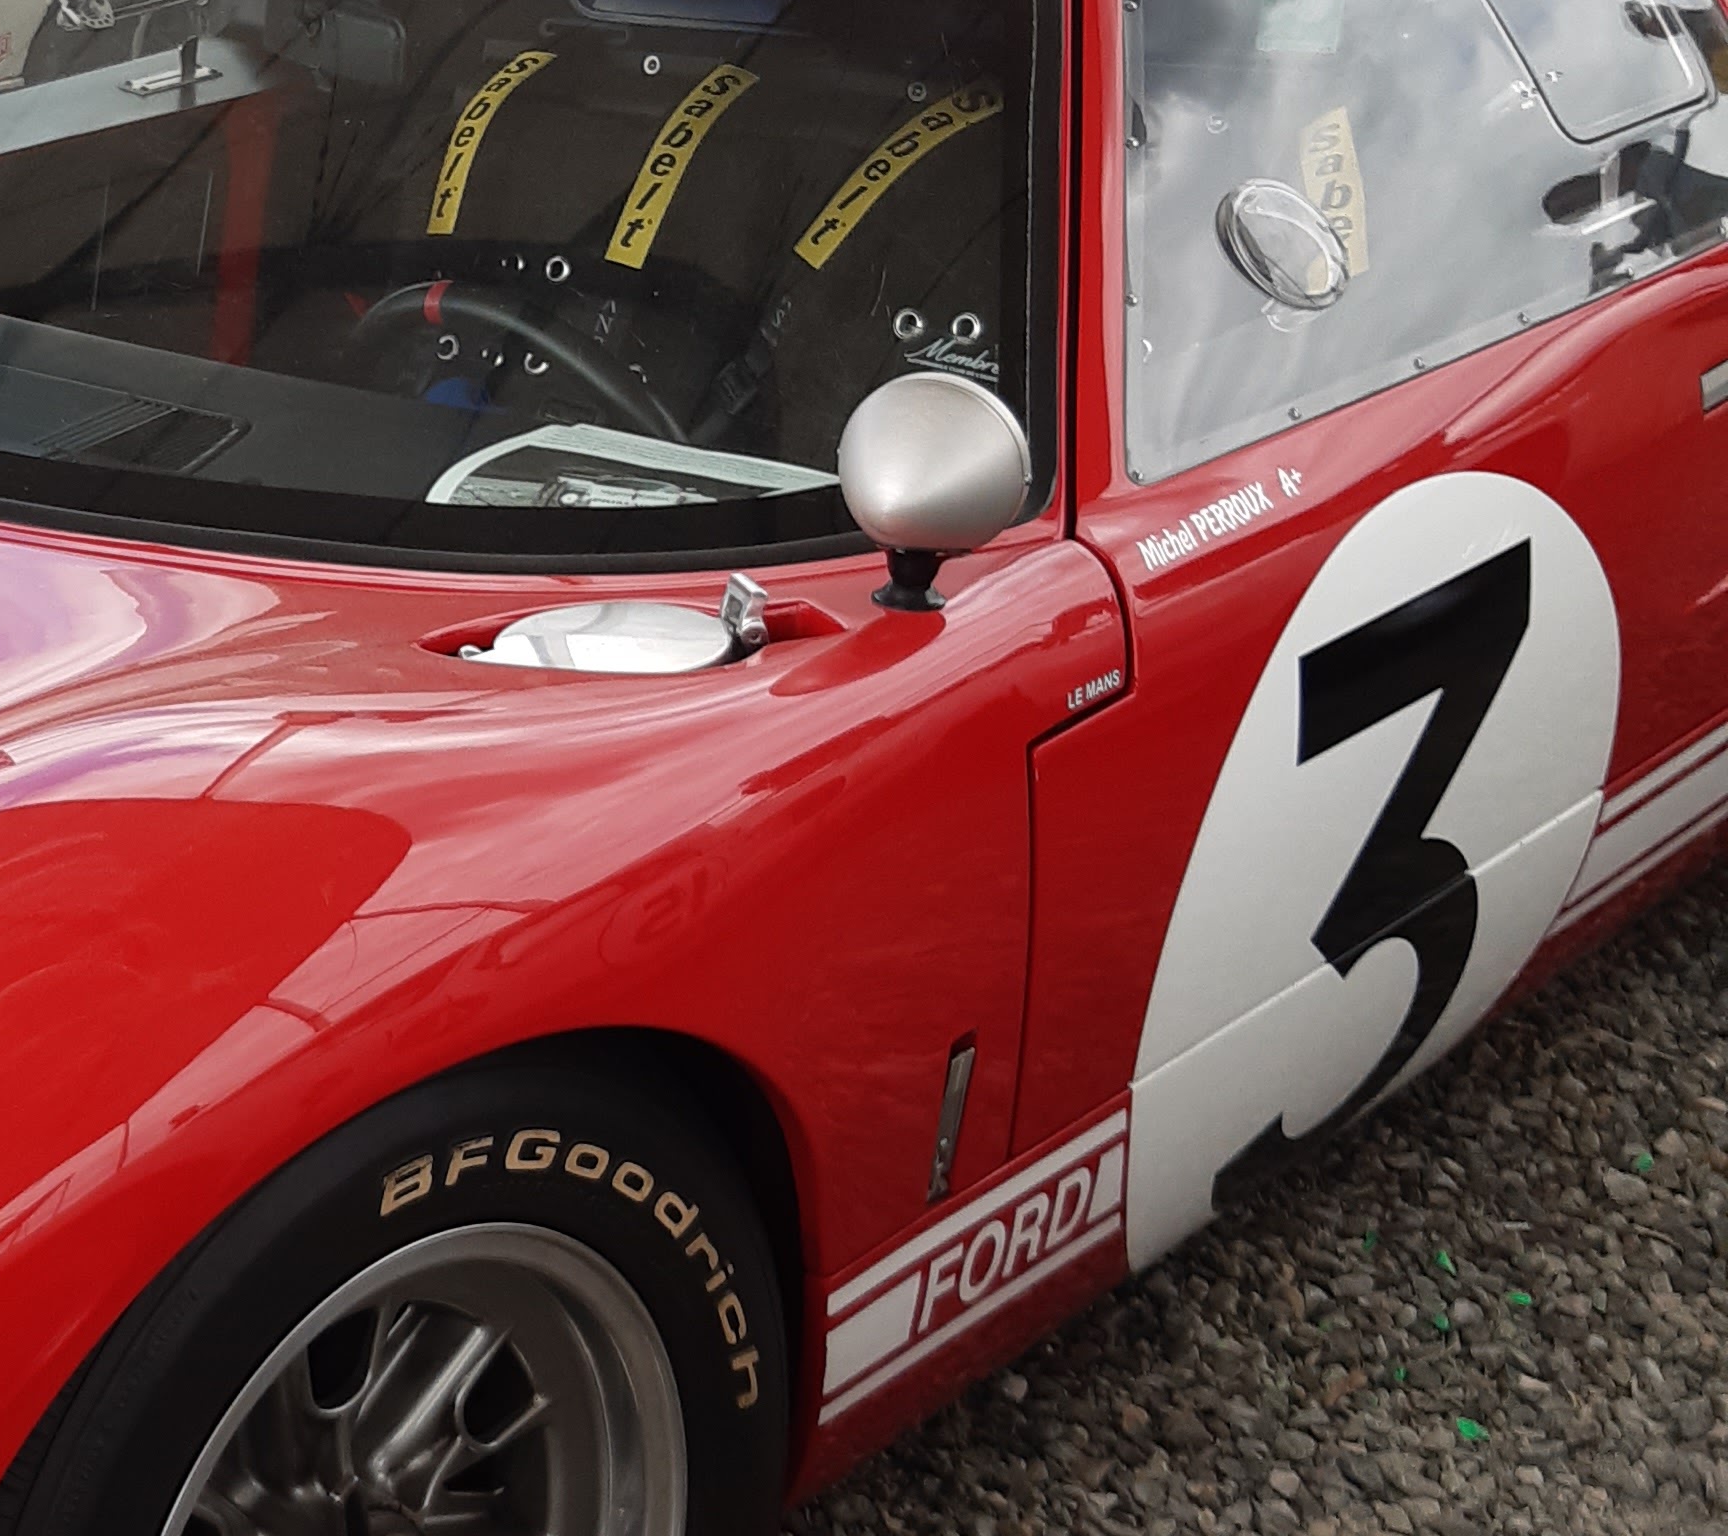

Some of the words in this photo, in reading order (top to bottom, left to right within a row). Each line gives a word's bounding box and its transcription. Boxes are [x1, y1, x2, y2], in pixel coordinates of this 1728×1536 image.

[435, 56, 541, 219] Sabelt
[619, 74, 742, 249] Sabelt
[810, 90, 997, 246] Sabelt
[1309, 122, 1353, 241] Sabe
[1136, 519, 1199, 572] Michel
[1189, 480, 1275, 542] PERROUX
[1277, 467, 1303, 498] A+
[1067, 686, 1084, 710] LE
[1085, 668, 1121, 701] MANS
[1210, 536, 1531, 1213] 3
[378, 1128, 761, 1410] BFGoodrich
[917, 1166, 1092, 1335] FORD
